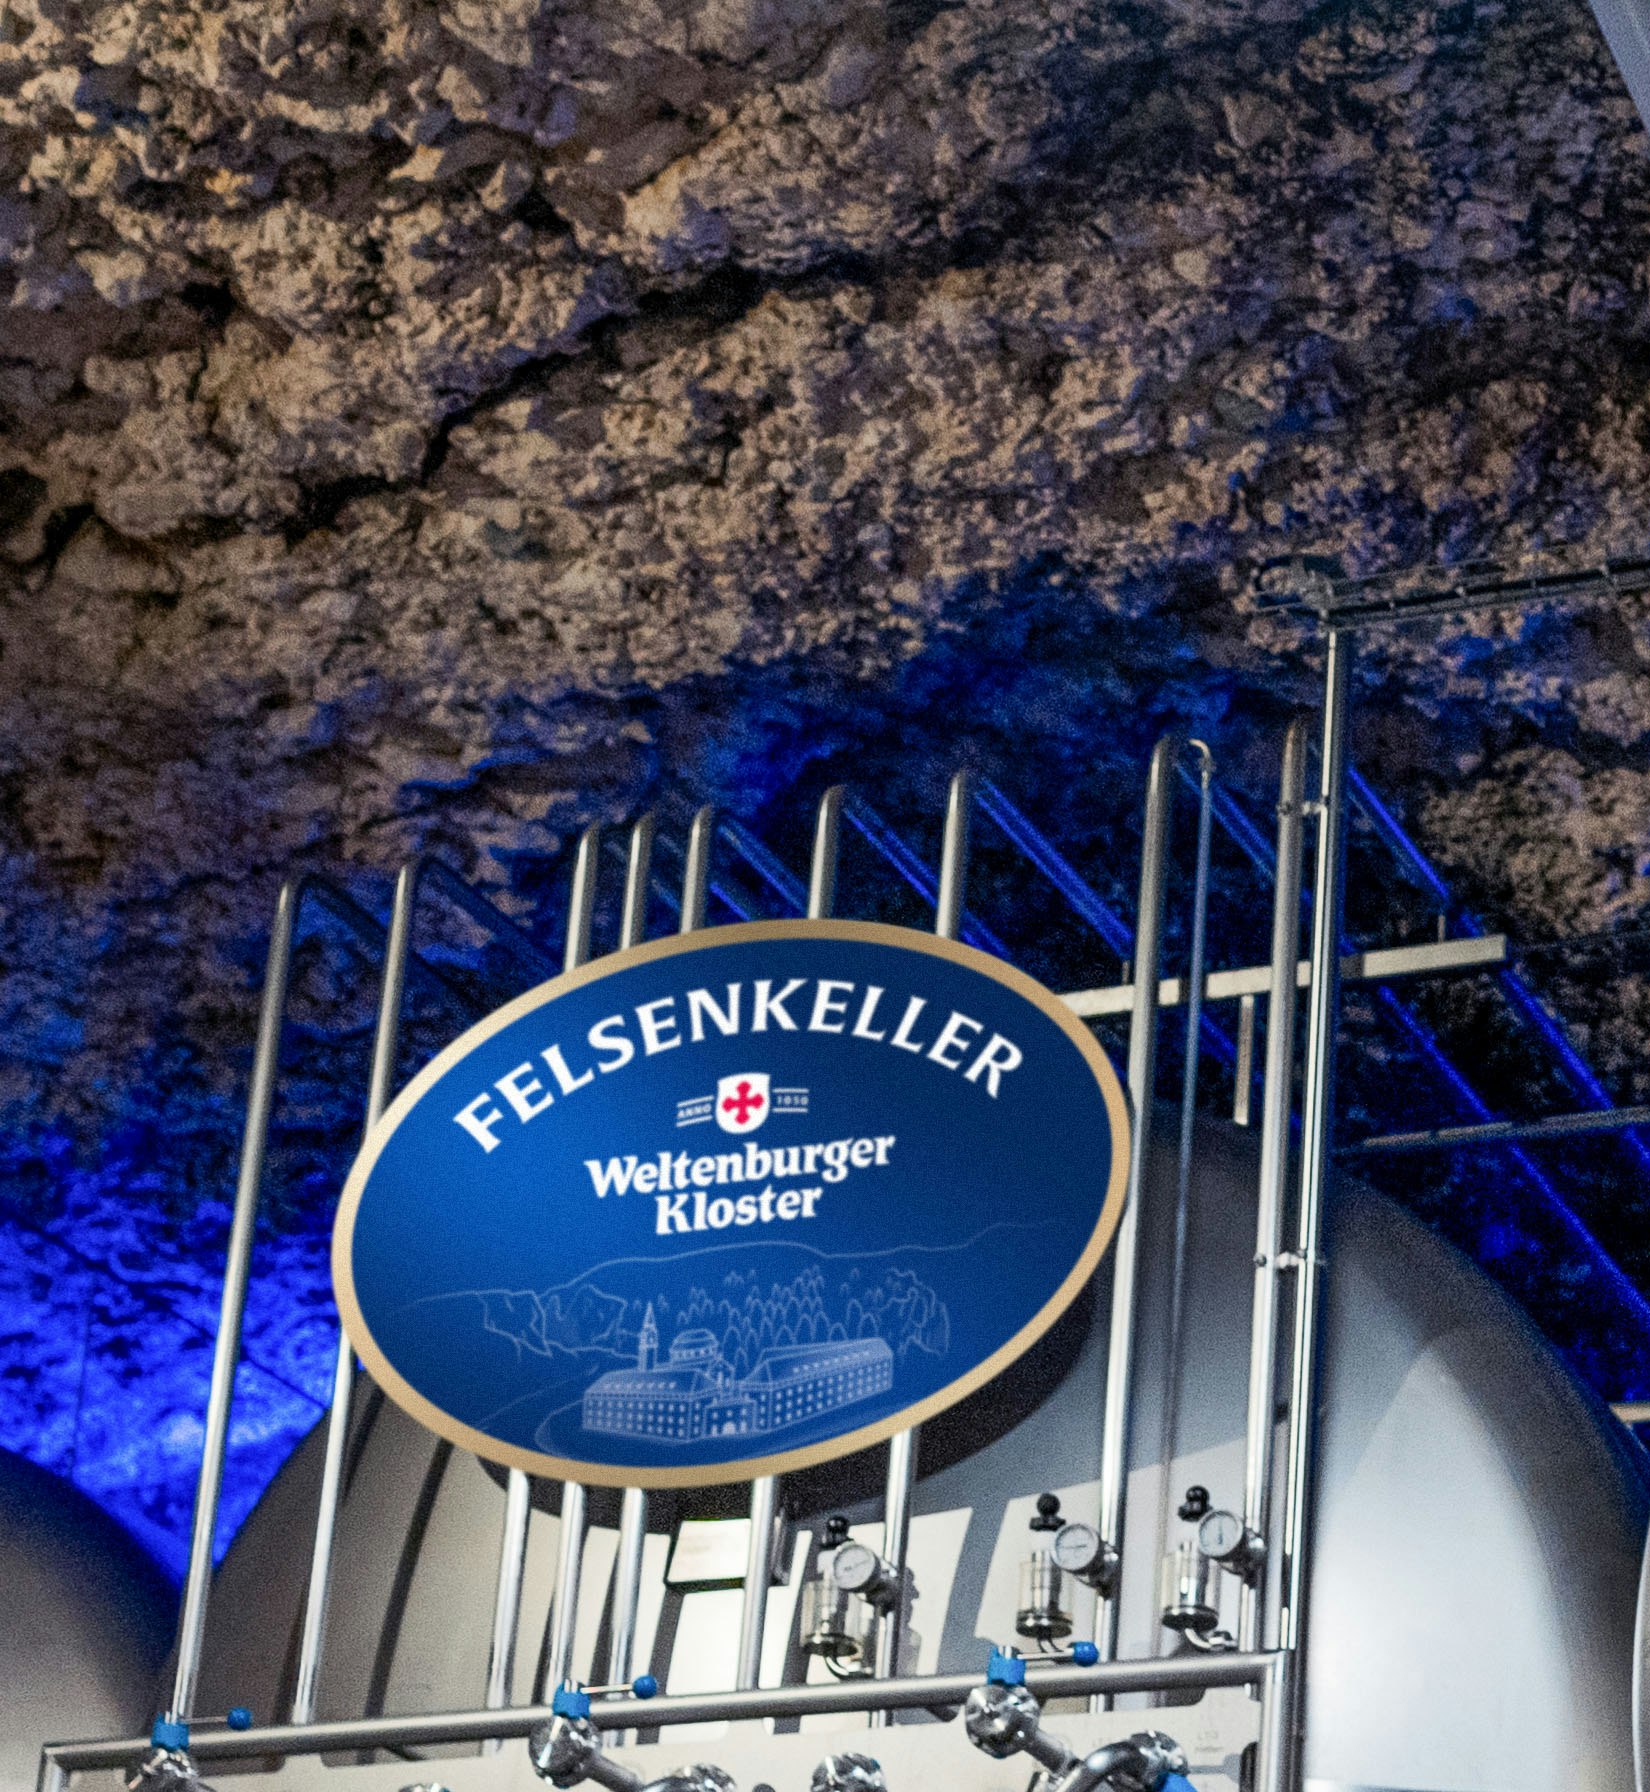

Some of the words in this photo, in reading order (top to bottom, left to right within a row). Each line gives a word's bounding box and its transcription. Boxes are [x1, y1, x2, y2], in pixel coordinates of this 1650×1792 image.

[453, 979, 1024, 1153] FELSENKELLER
[584, 1135, 896, 1199] Weltenburger
[655, 1184, 823, 1235] Kloster
